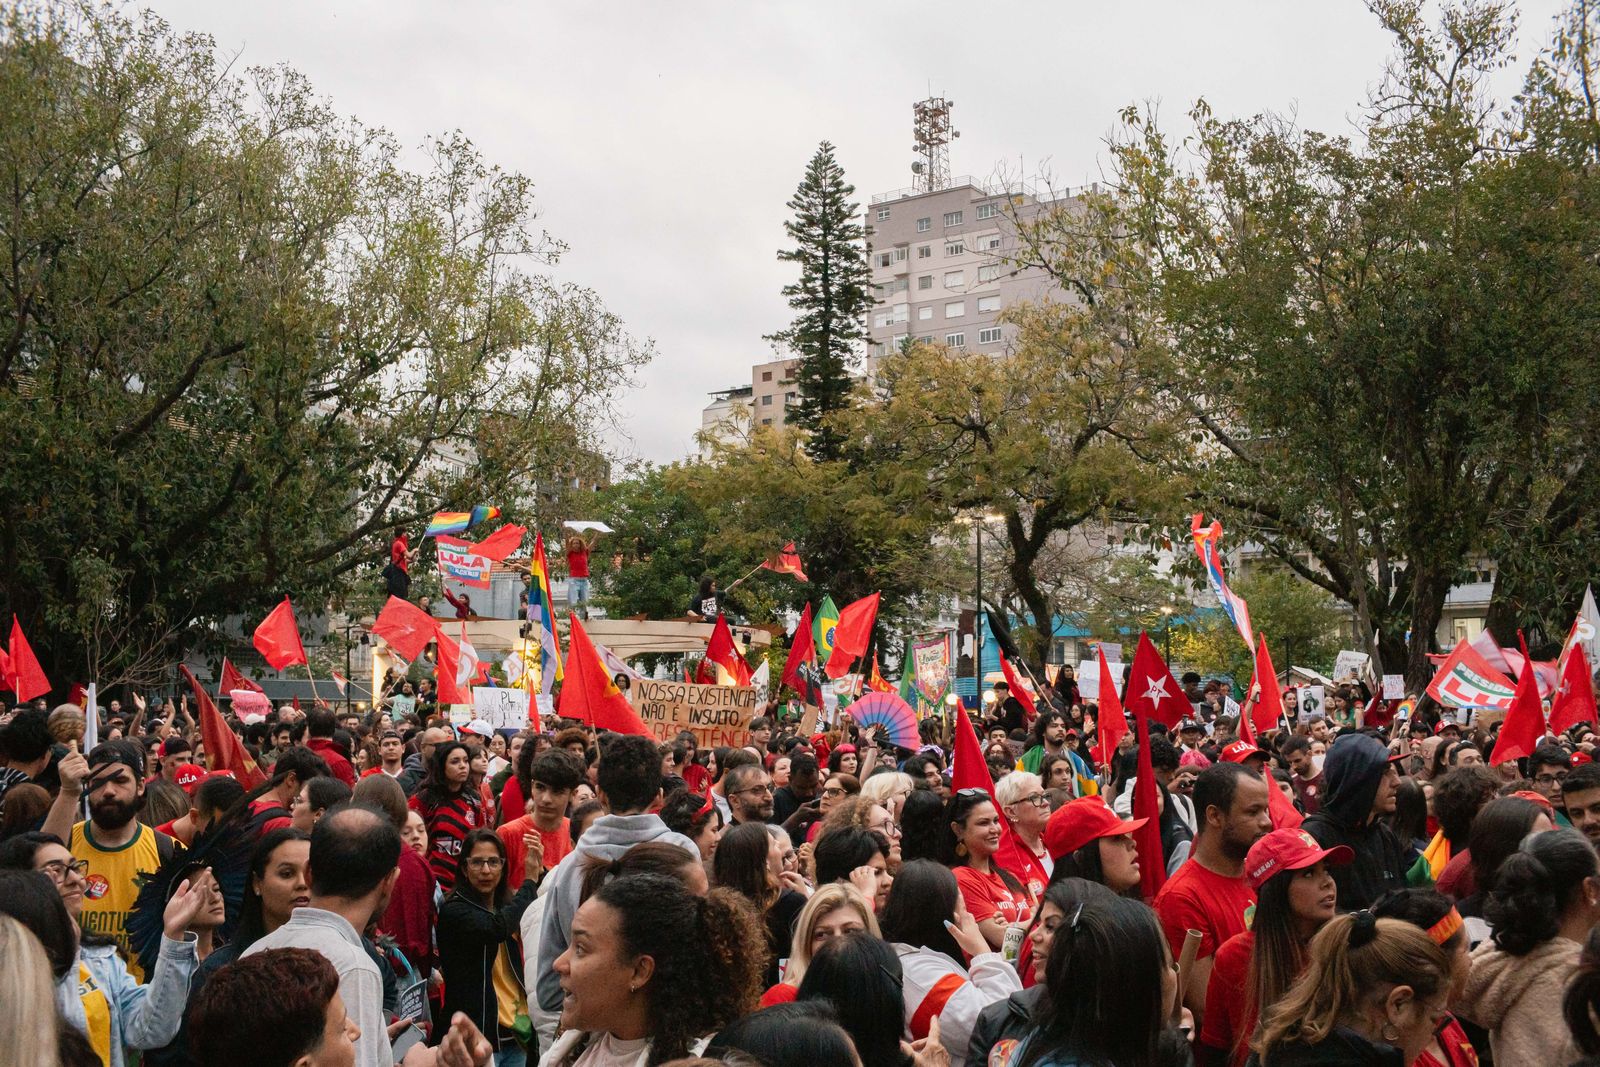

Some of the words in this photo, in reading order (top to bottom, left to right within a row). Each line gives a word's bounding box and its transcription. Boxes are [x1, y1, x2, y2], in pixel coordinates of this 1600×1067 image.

[440, 551, 485, 568] LULA
[501, 690, 516, 704] PL
[638, 682, 686, 704] NOSSA
[687, 685, 757, 708] EXISTÊNCIA
[1149, 685, 1163, 699] PT
[641, 701, 666, 721] NÃO
[672, 705, 680, 722] É
[688, 706, 744, 728] INSULTO,
[178, 773, 197, 785] LULA
[1006, 933, 1023, 944] BALY
